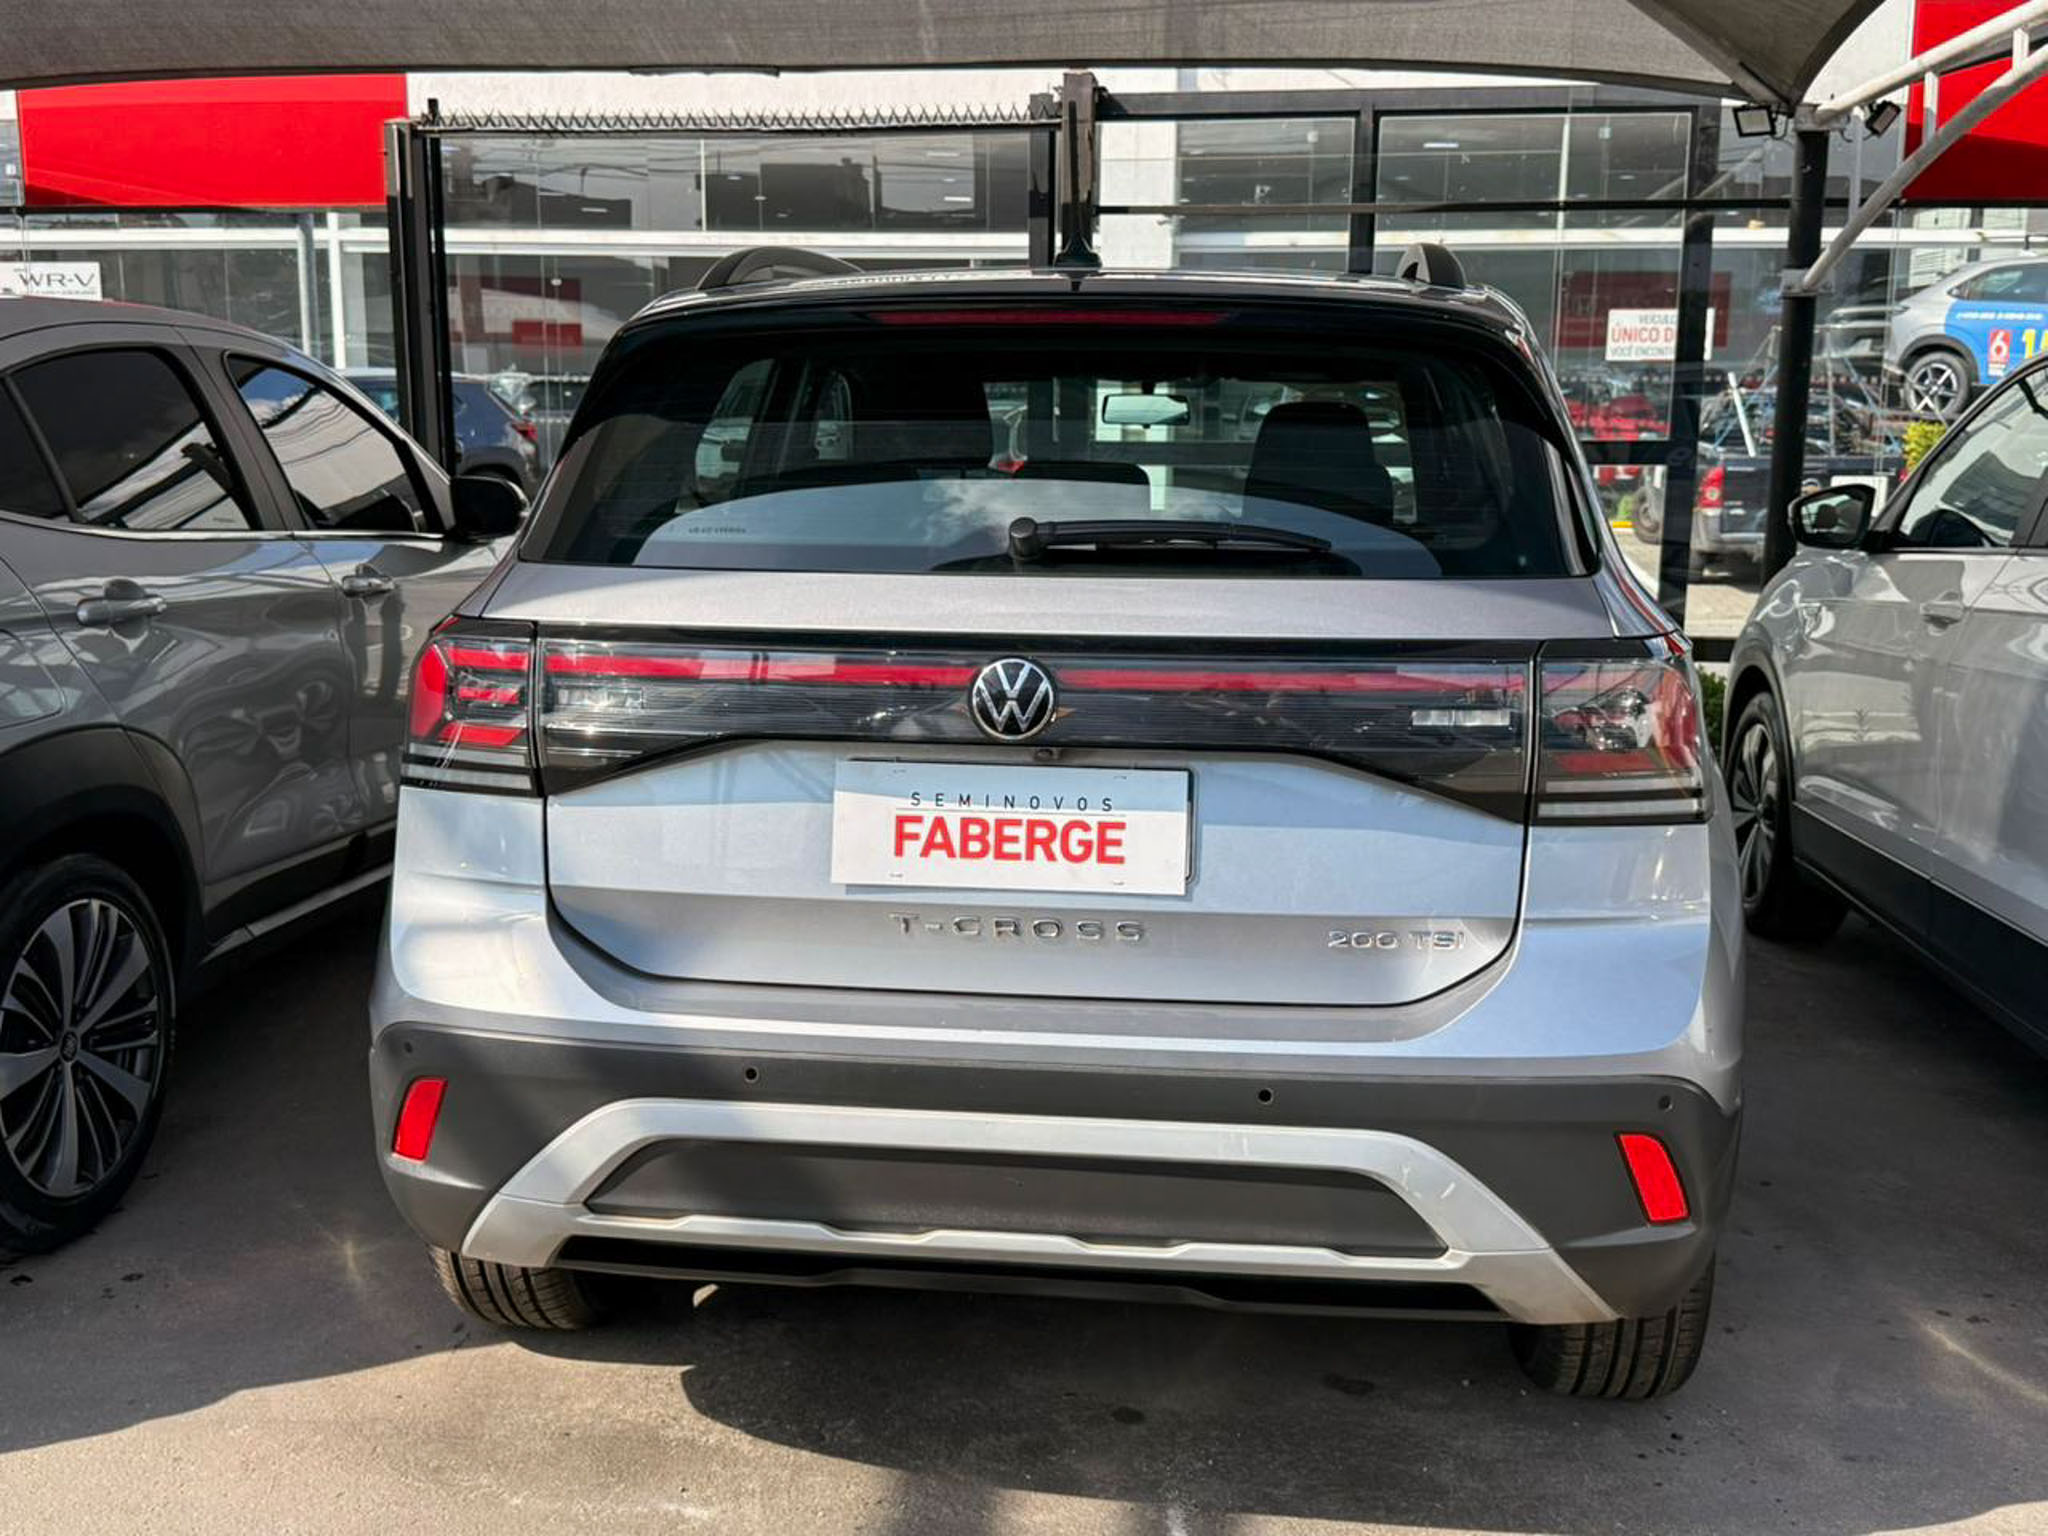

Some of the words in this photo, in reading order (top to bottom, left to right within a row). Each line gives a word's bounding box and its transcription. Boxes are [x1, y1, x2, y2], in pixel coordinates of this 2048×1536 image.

[19, 273, 95, 287] WR-V
[910, 791, 1114, 812] SEMINOVOS
[894, 815, 1127, 865] FABERGE
[889, 912, 1146, 942] T-CROSS
[1327, 930, 1399, 950] 200
[1408, 930, 1466, 951] TSI
